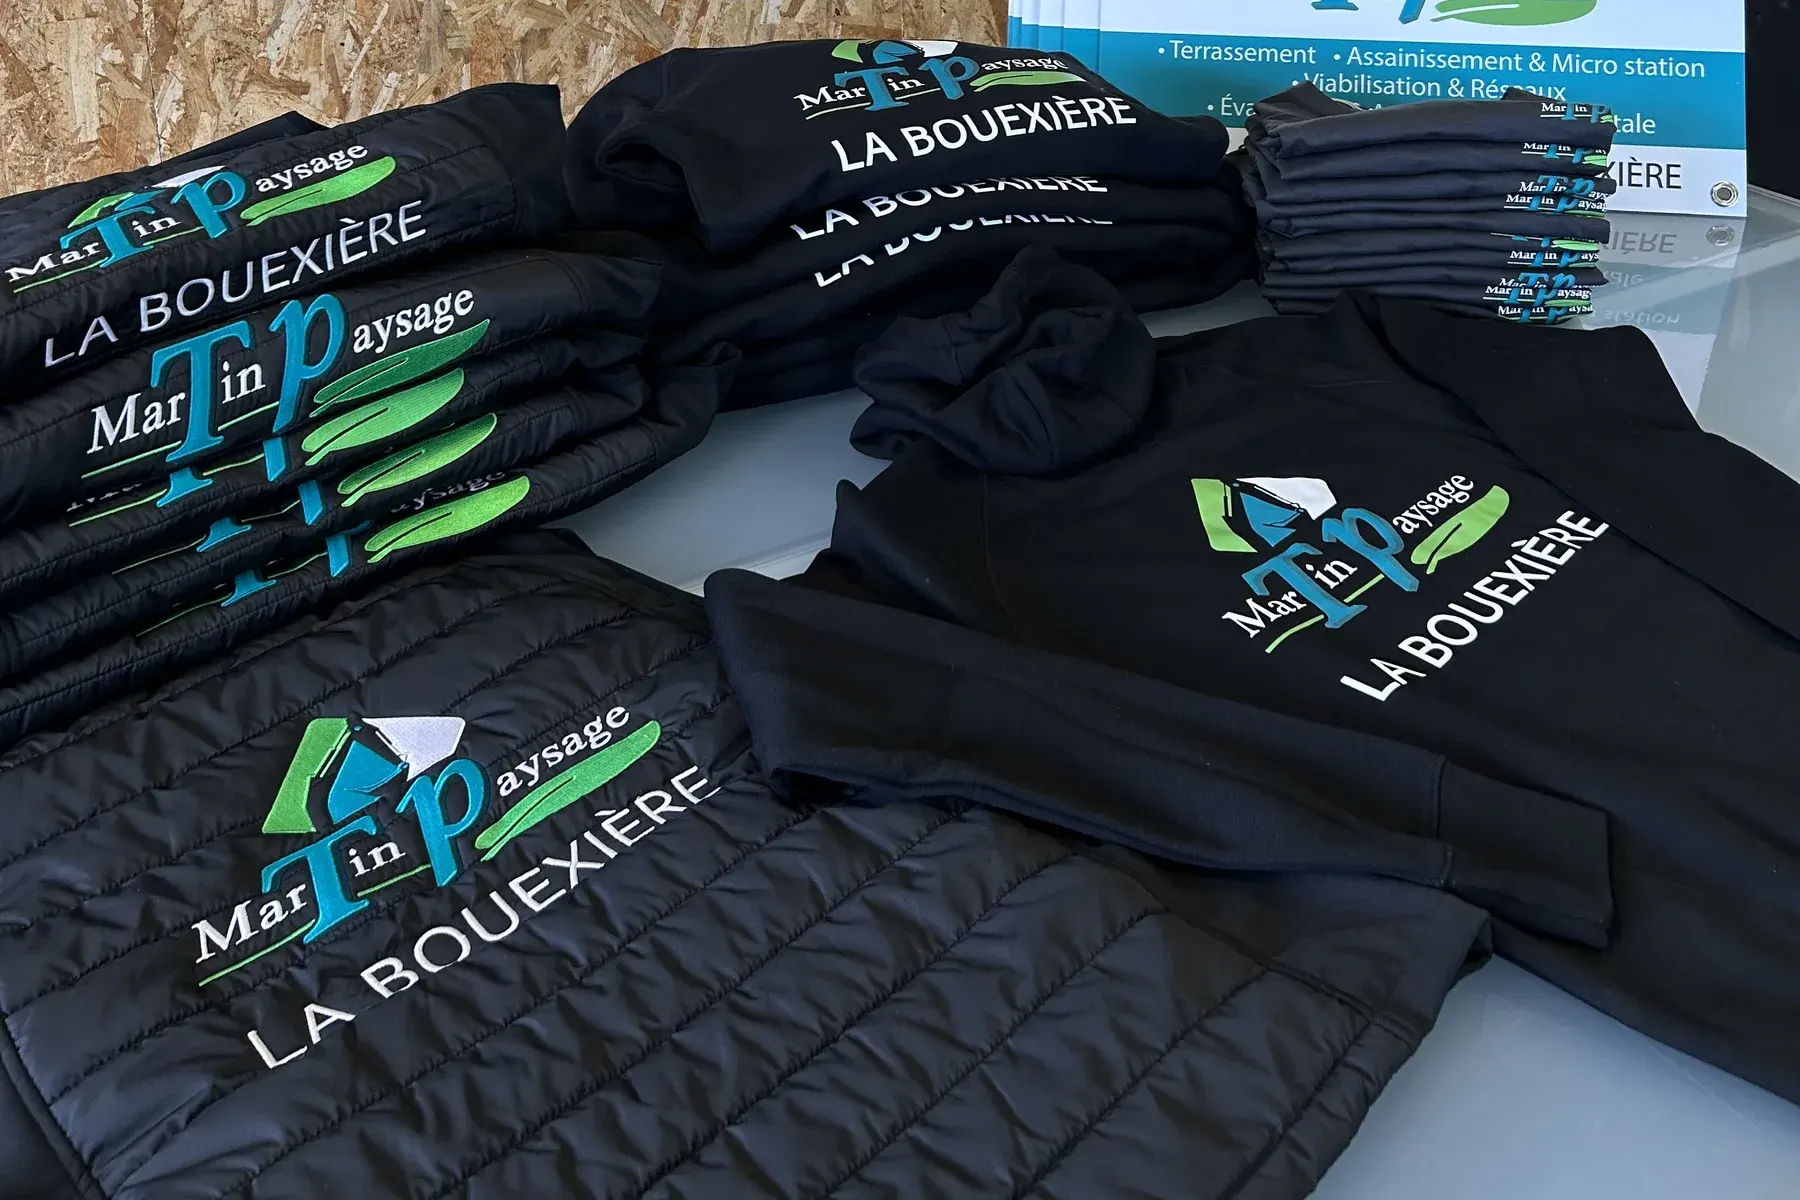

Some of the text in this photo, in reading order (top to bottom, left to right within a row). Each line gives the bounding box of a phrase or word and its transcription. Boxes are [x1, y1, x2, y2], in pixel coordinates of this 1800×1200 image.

[1169, 40, 1706, 78] Terrassement Assainissement & Micro station
[1447, 78, 1465, 98] &
[1471, 79, 1567, 101] Résaux
[831, 95, 1137, 172] LA BOUEXIÈRE
[1614, 113, 1657, 134] tale
[790, 208, 860, 241] LA
[44, 200, 428, 368] LA BOUEXIÈRE
[1340, 510, 1609, 701] LA BOUEXIÈRE
[247, 765, 722, 1069] LA BOUEXIÈRE
